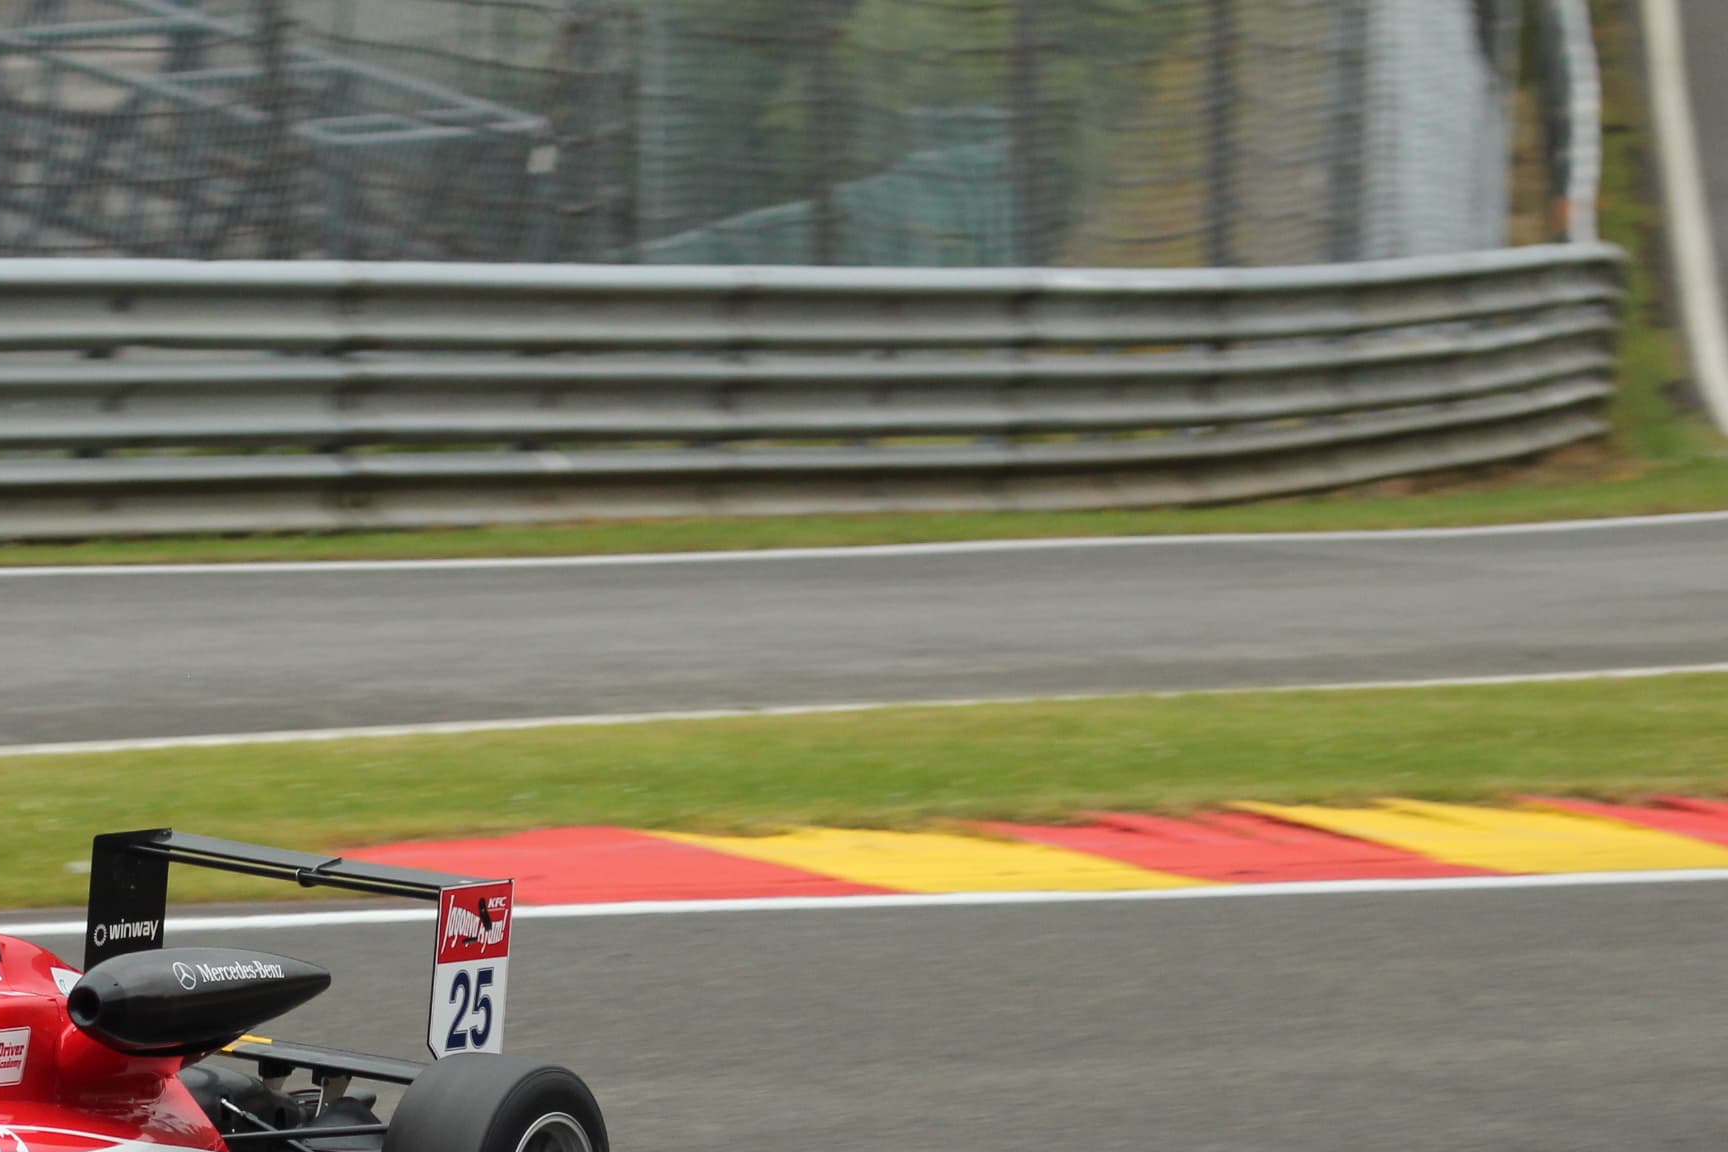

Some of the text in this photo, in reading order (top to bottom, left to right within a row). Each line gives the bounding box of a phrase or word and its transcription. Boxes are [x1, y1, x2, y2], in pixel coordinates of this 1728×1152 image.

[487, 896, 507, 909] KFC
[109, 918, 159, 941] winway
[196, 960, 285, 983] Mercedes-Benz
[445, 967, 494, 1052] 25
